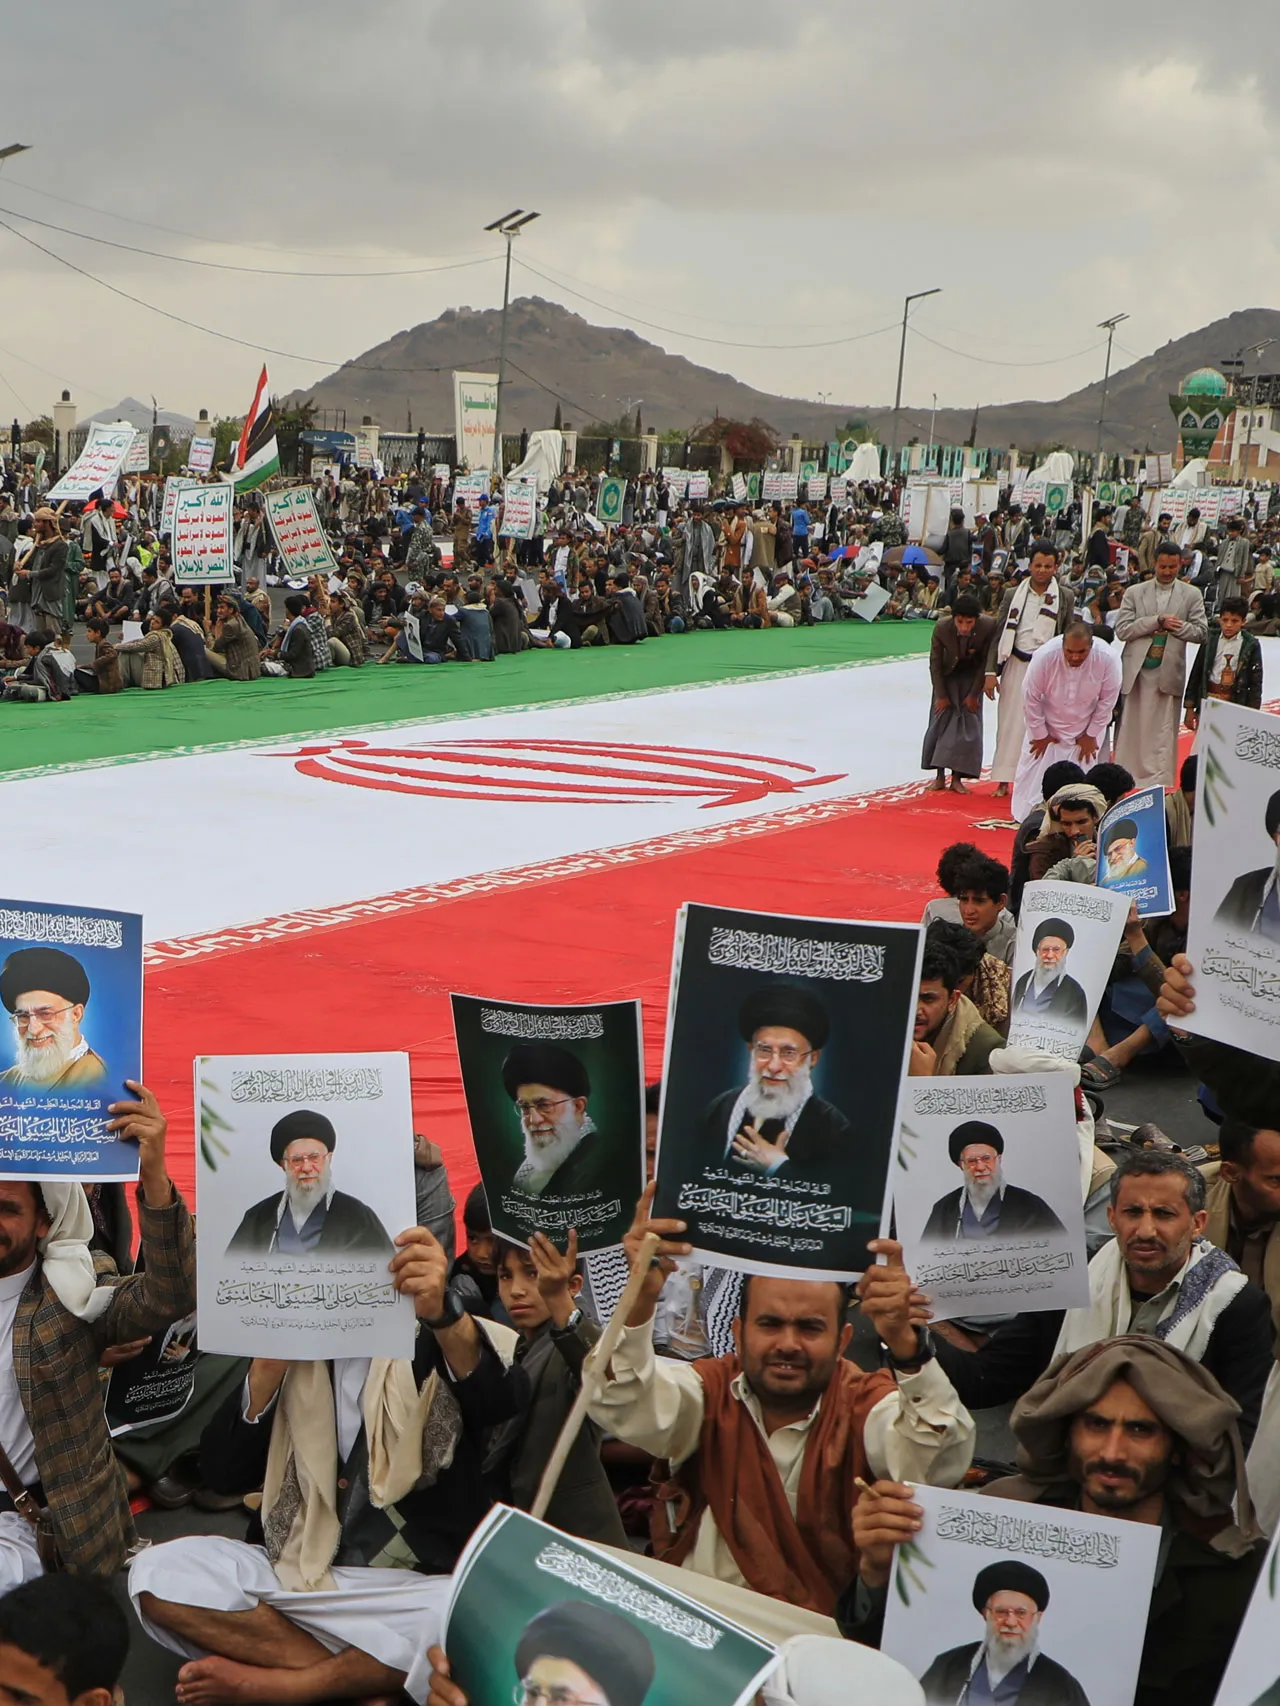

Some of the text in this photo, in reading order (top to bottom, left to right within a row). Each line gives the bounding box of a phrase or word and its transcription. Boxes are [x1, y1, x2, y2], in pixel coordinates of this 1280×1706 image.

[209, 490, 228, 506] الله
[293, 488, 311, 505] الله
[205, 510, 228, 524] الموت
[295, 507, 315, 522] الموت
[204, 527, 228, 540] الموت
[301, 522, 320, 537] الموت
[205, 555, 228, 575] النصر
